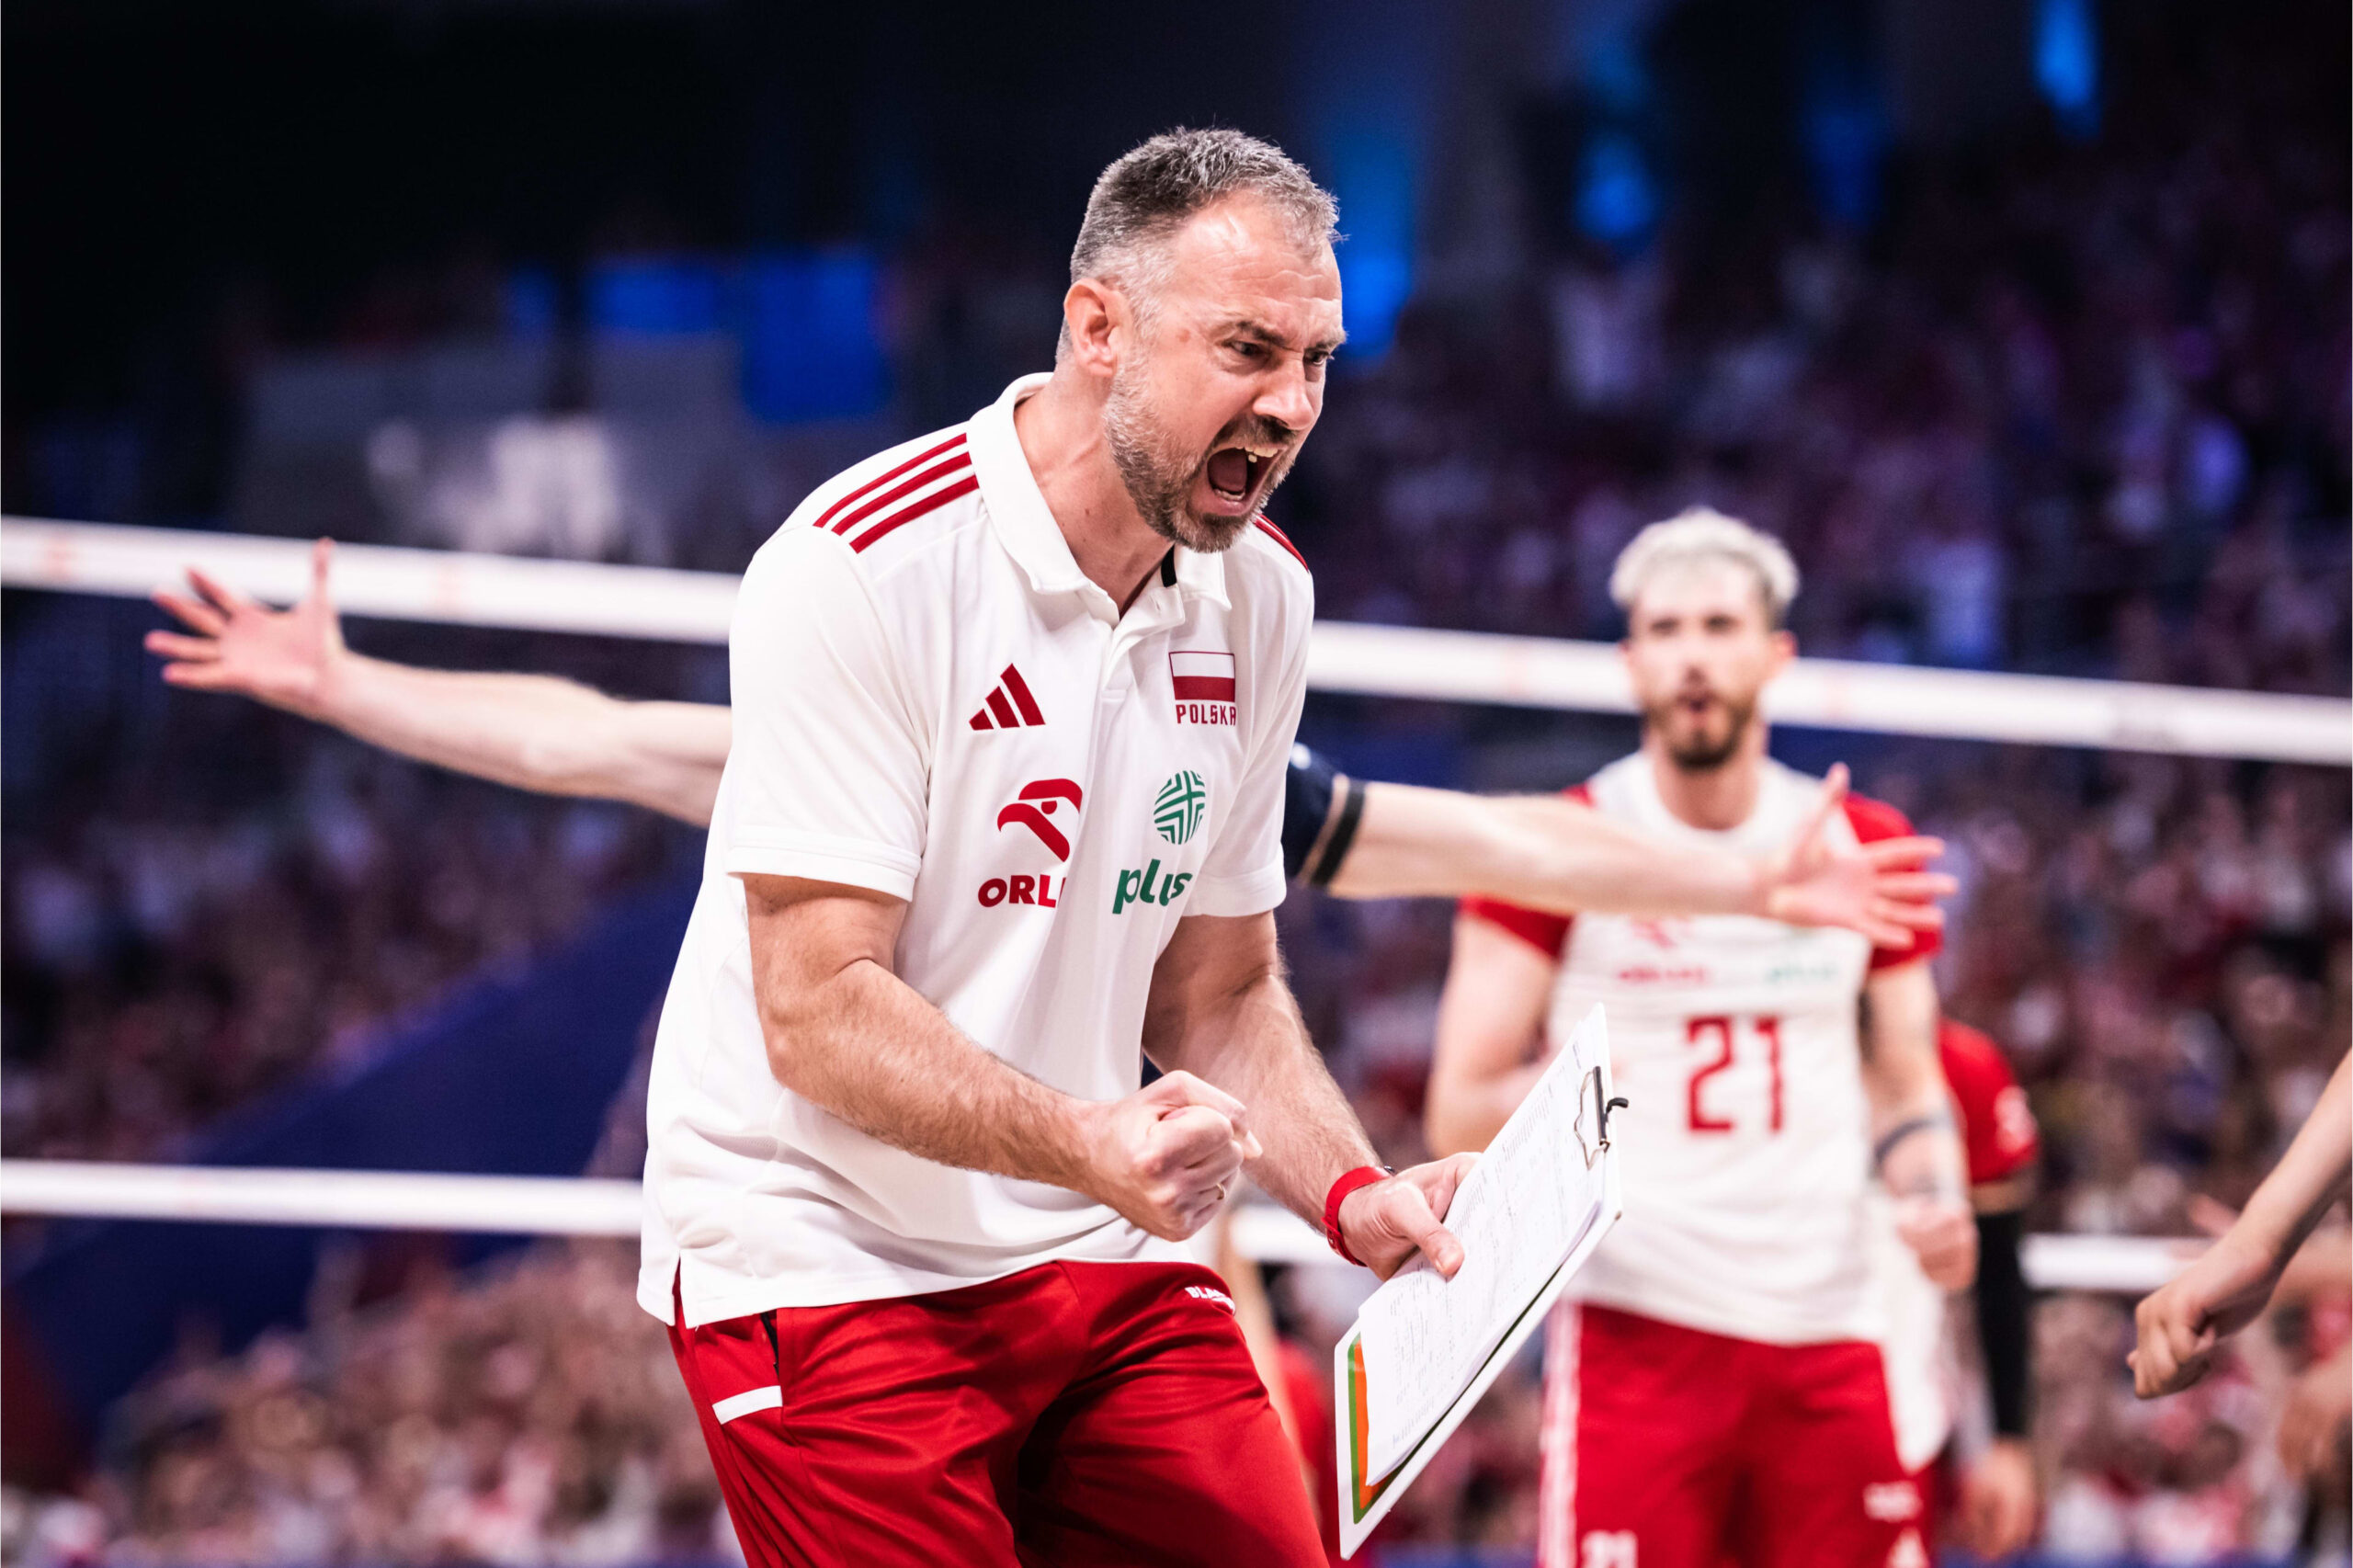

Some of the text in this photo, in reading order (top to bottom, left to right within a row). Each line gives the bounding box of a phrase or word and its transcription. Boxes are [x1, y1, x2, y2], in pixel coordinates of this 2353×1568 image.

[1176, 703, 1236, 726] POLSKA
[977, 874, 1066, 908] ORL
[1686, 1015, 1783, 1133] 21
